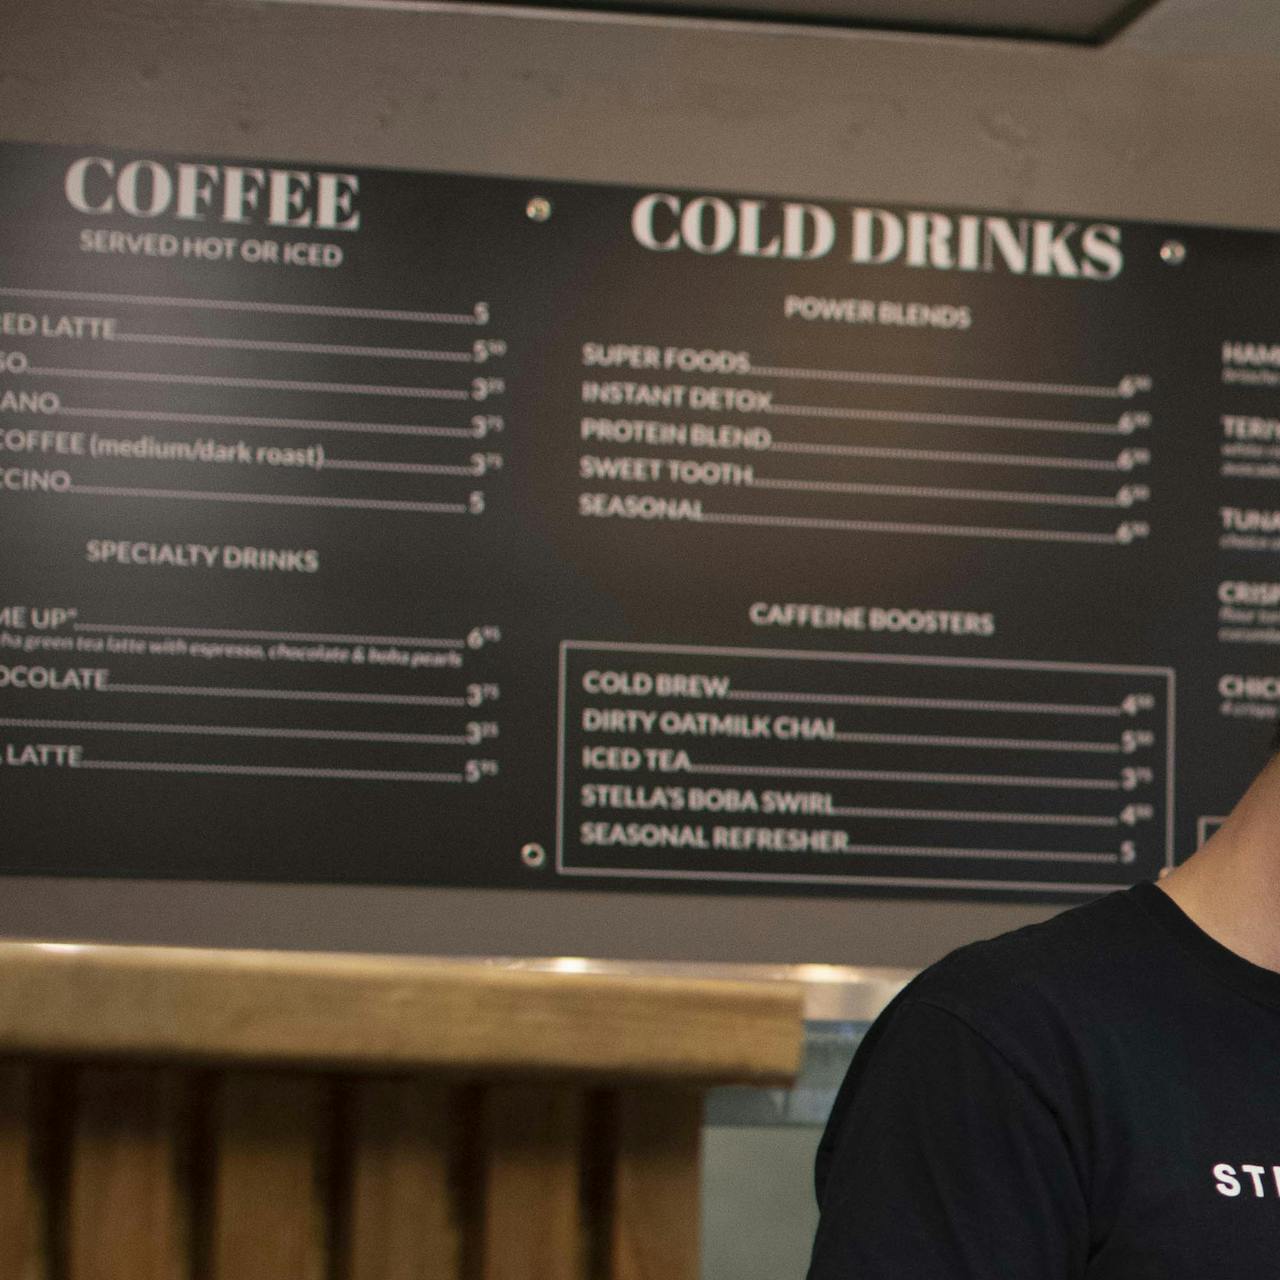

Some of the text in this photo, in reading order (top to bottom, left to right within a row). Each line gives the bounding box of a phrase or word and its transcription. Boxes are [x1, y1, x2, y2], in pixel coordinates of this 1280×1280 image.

[64, 156, 361, 231] COFFEE
[80, 230, 343, 267] SERVED HOT OR ICED
[631, 192, 1123, 281] COLD DRINKS
[41, 315, 118, 341] LATTE
[784, 295, 971, 331] POWER BLENDS
[581, 341, 661, 371] SUPER
[664, 347, 751, 376] FOODS
[581, 381, 687, 409] INSTANT
[689, 386, 774, 414] DETOX
[0, 427, 86, 454] OFFEE
[256, 444, 325, 471] roast)
[580, 417, 687, 447] PROTEIN
[690, 421, 773, 450] BLEND
[0, 466, 71, 493] CINO
[579, 454, 666, 484] SWEET
[667, 457, 755, 488] TOOTH
[578, 491, 705, 523] SEASONAL
[86, 539, 320, 573] SPECIALTY DRINKS
[749, 602, 996, 636] CAFFEINE BOOSTERS
[24, 635, 73, 652] green
[76, 636, 103, 651] tea
[106, 637, 147, 654] latte
[150, 637, 188, 655] with
[268, 642, 350, 664] chocolate
[581, 669, 653, 696] COLD
[655, 674, 731, 700] BREW
[581, 707, 663, 735] DIRTY
[661, 710, 772, 738] OATMILK
[773, 715, 837, 741] CHAI
[7, 744, 84, 769] LATTE
[581, 747, 643, 772] ICED
[644, 749, 693, 773] TEA
[580, 783, 686, 811] STELLA'S
[688, 787, 760, 813] BOBA
[761, 790, 837, 816] SWIRL
[579, 822, 708, 850] SEASONAL
[711, 826, 849, 854] REFRESHER
